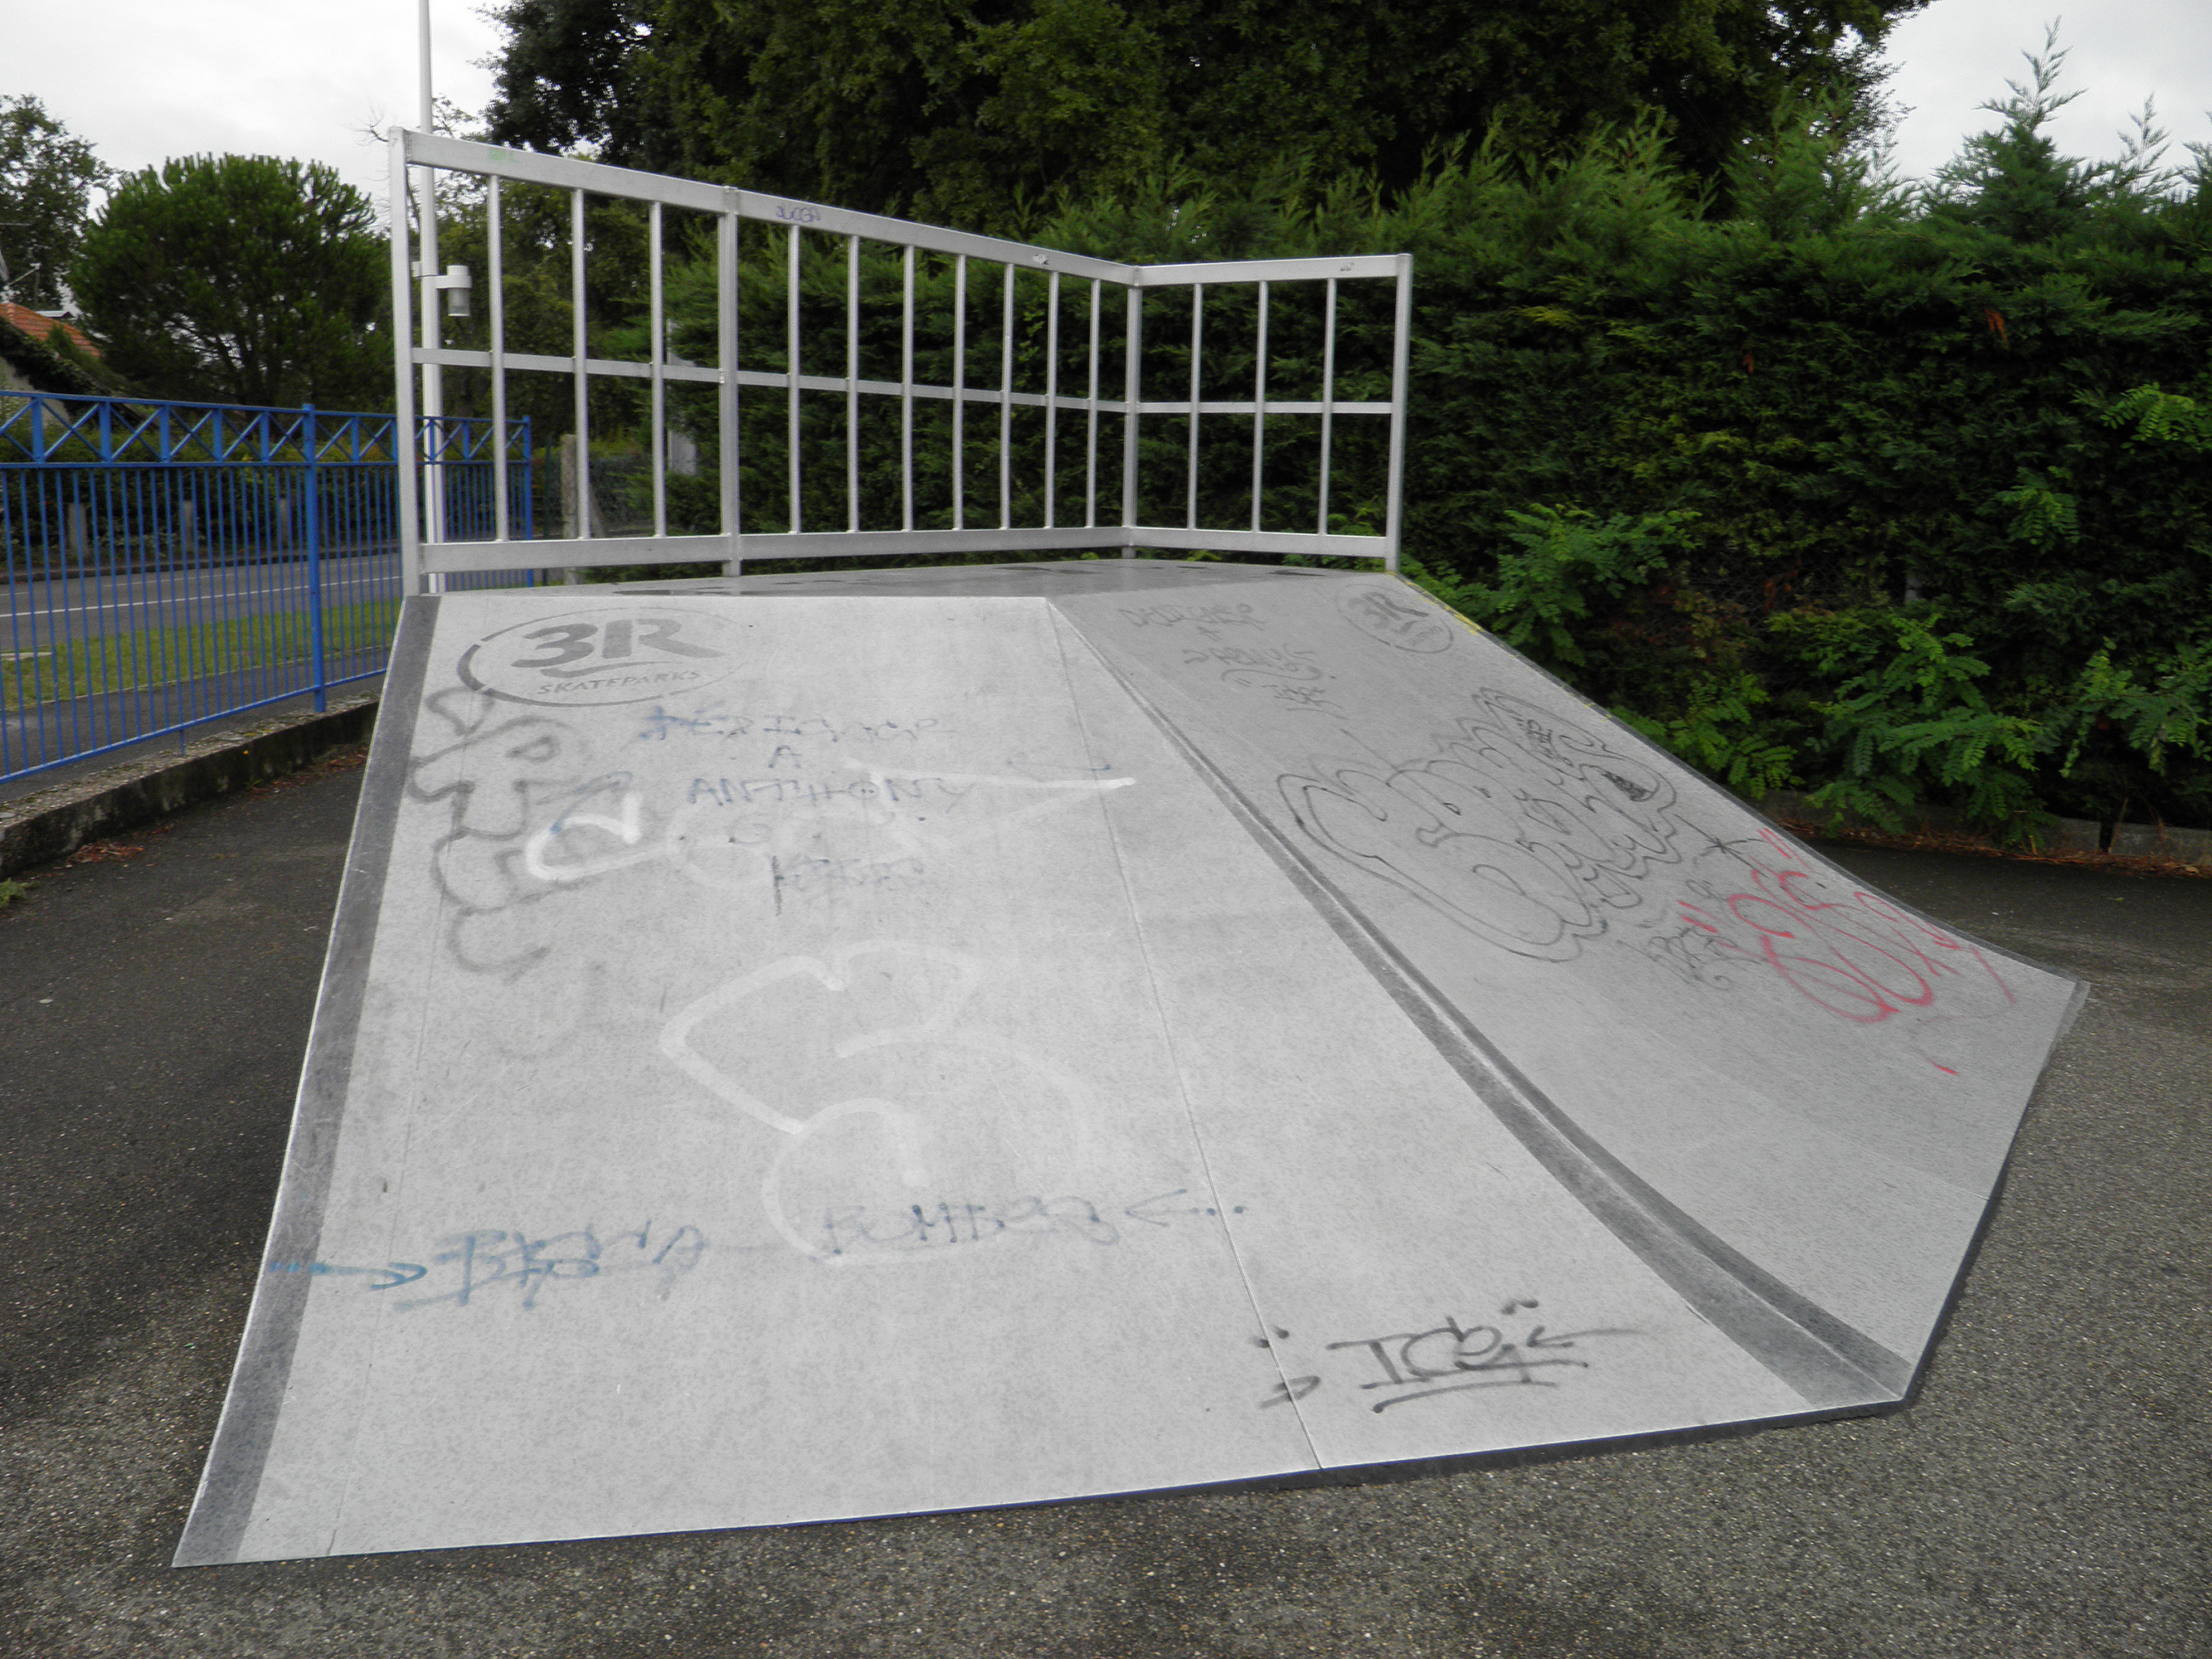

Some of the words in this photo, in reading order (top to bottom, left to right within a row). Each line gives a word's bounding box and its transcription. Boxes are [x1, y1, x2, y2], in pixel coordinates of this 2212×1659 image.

[512, 619, 727, 669] 3R
[537, 670, 702, 695] SKATEPARKS
[767, 745, 803, 768] A
[687, 776, 979, 815] ANTHONY
